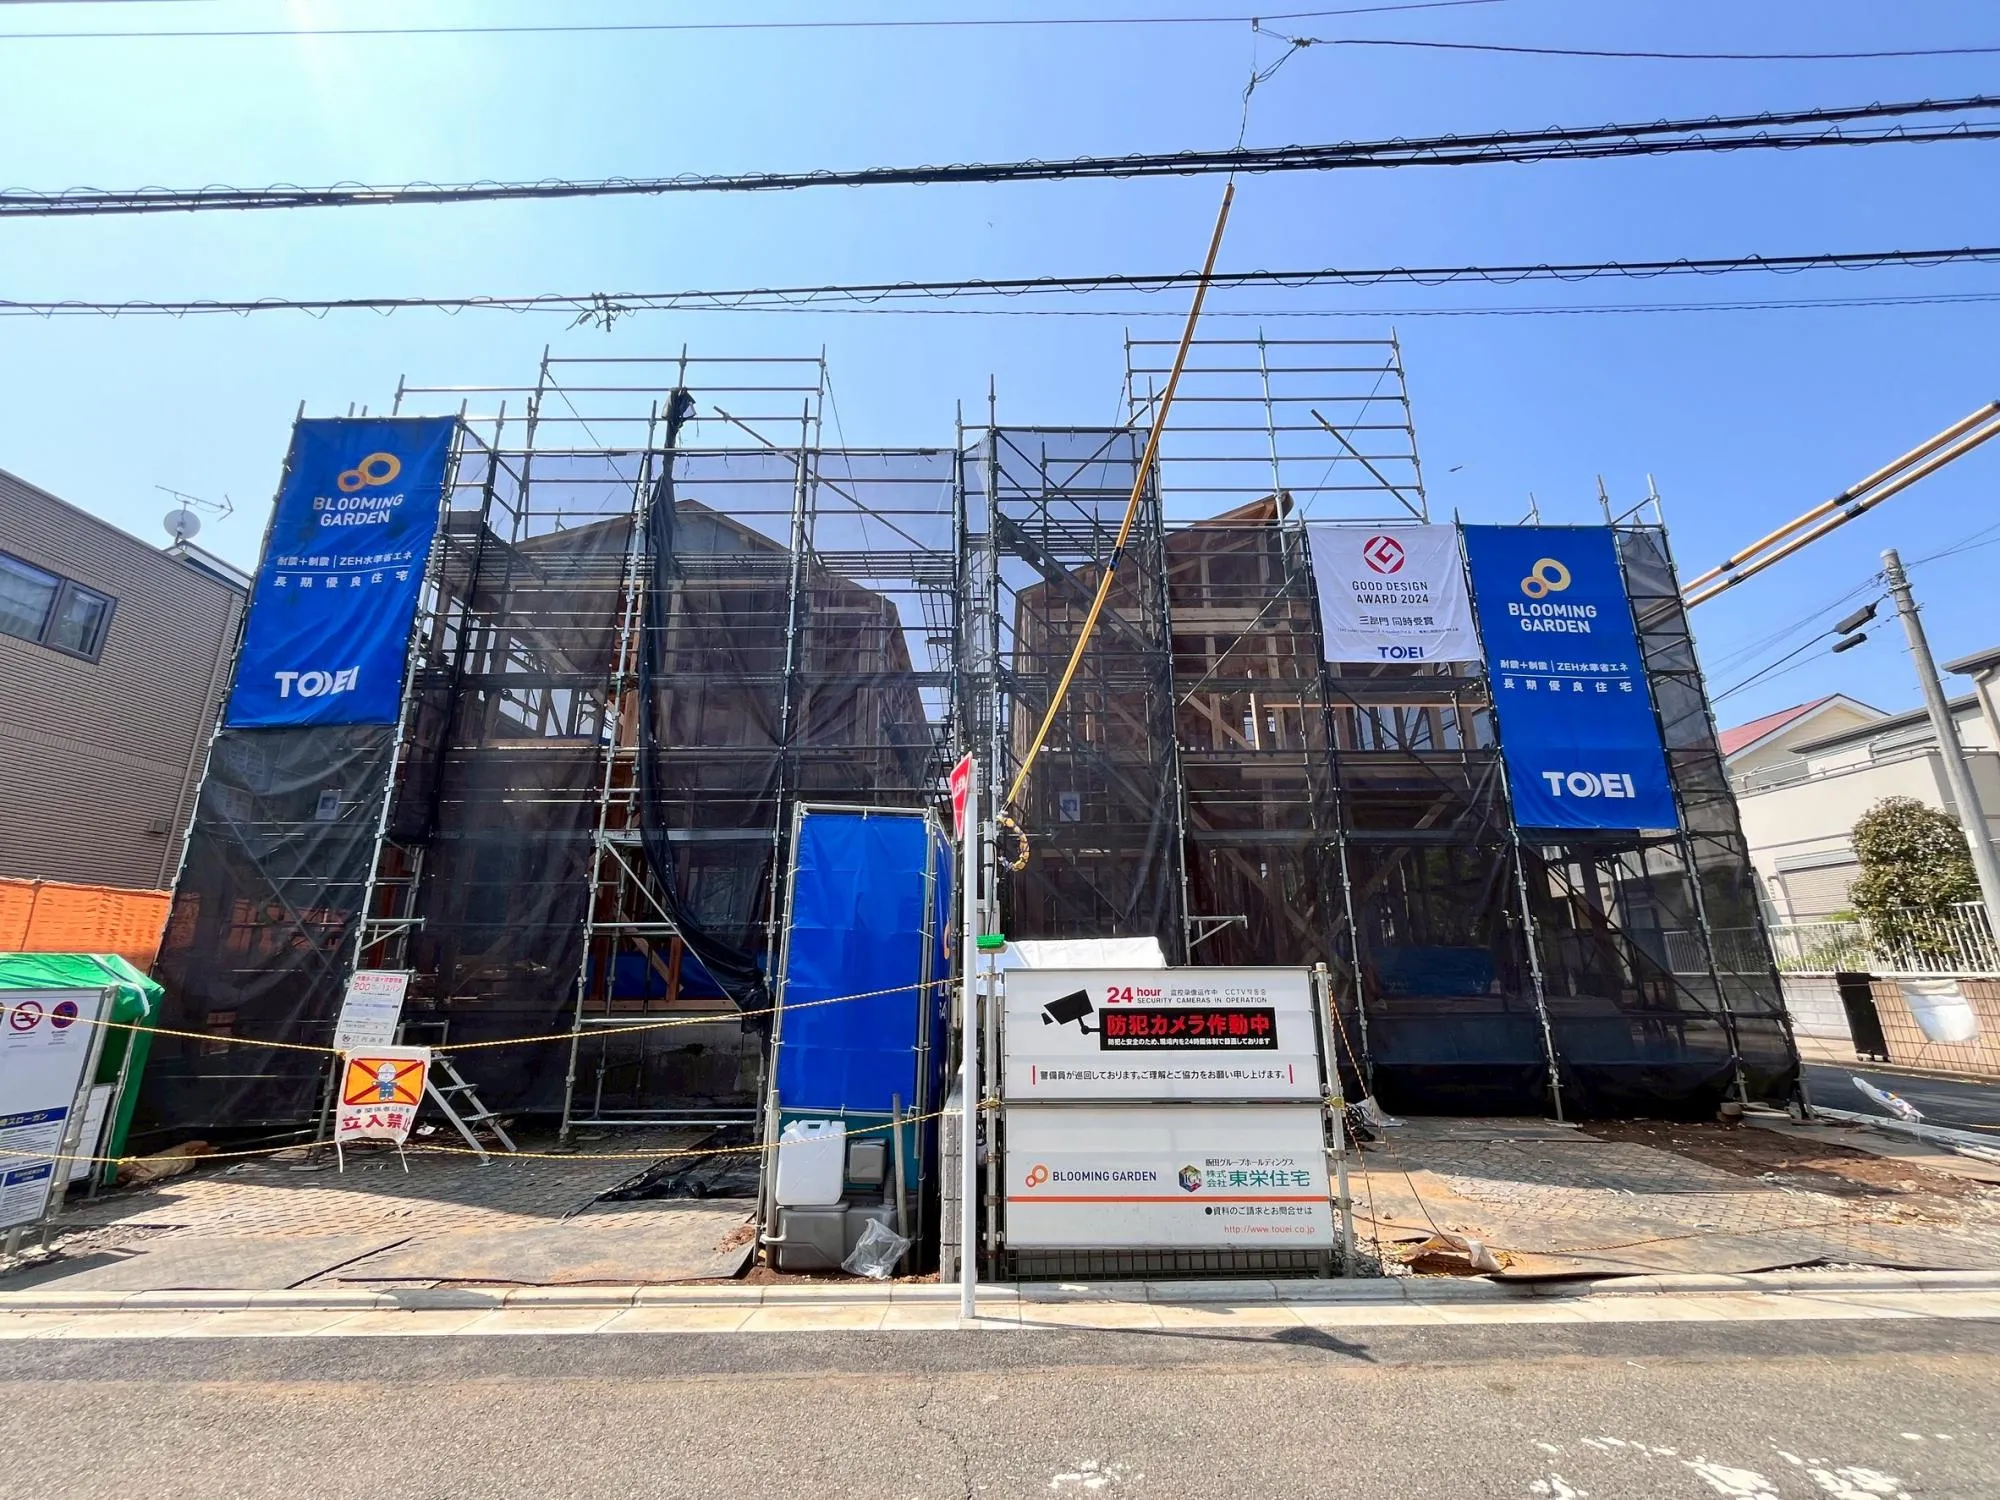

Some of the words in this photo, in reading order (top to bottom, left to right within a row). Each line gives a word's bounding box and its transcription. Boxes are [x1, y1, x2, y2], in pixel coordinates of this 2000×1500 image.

[313, 494, 404, 511] BLOOMING
[320, 509, 390, 527] GARDEN
[274, 569, 409, 588] 長期優良住宅
[1352, 580, 1383, 591] GOOD
[1386, 580, 1428, 591] DESIGN
[1357, 593, 1397, 604] AWARD
[1400, 593, 1429, 604] 2024
[1508, 602, 1597, 618] BLOOMING
[1359, 615, 1389, 626] 三部門
[1392, 616, 1434, 626] 同時受賞
[1520, 618, 1591, 633] GARDEN
[1503, 678, 1632, 692] 長期優良住宅
[1106, 987, 1134, 1003] 24
[1136, 987, 1162, 996] hour
[1106, 1014, 1270, 1035] 防犯カメラ作動中
[1040, 1070, 1285, 1081] 警備員が巡回しております。ご理解とご協力をお願い申し上げます。
[1205, 1158, 1295, 1167] 飯田グループホールディングス
[1052, 1171, 1110, 1181] BLOOMING
[1112, 1171, 1157, 1181] GARDEN
[1206, 1170, 1226, 1178] 株式
[1228, 1169, 1310, 1187] 東栄住宅
[1207, 1179, 1227, 1188] 会社
[1224, 1225, 1315, 1235] http://www.touei.co.jp
